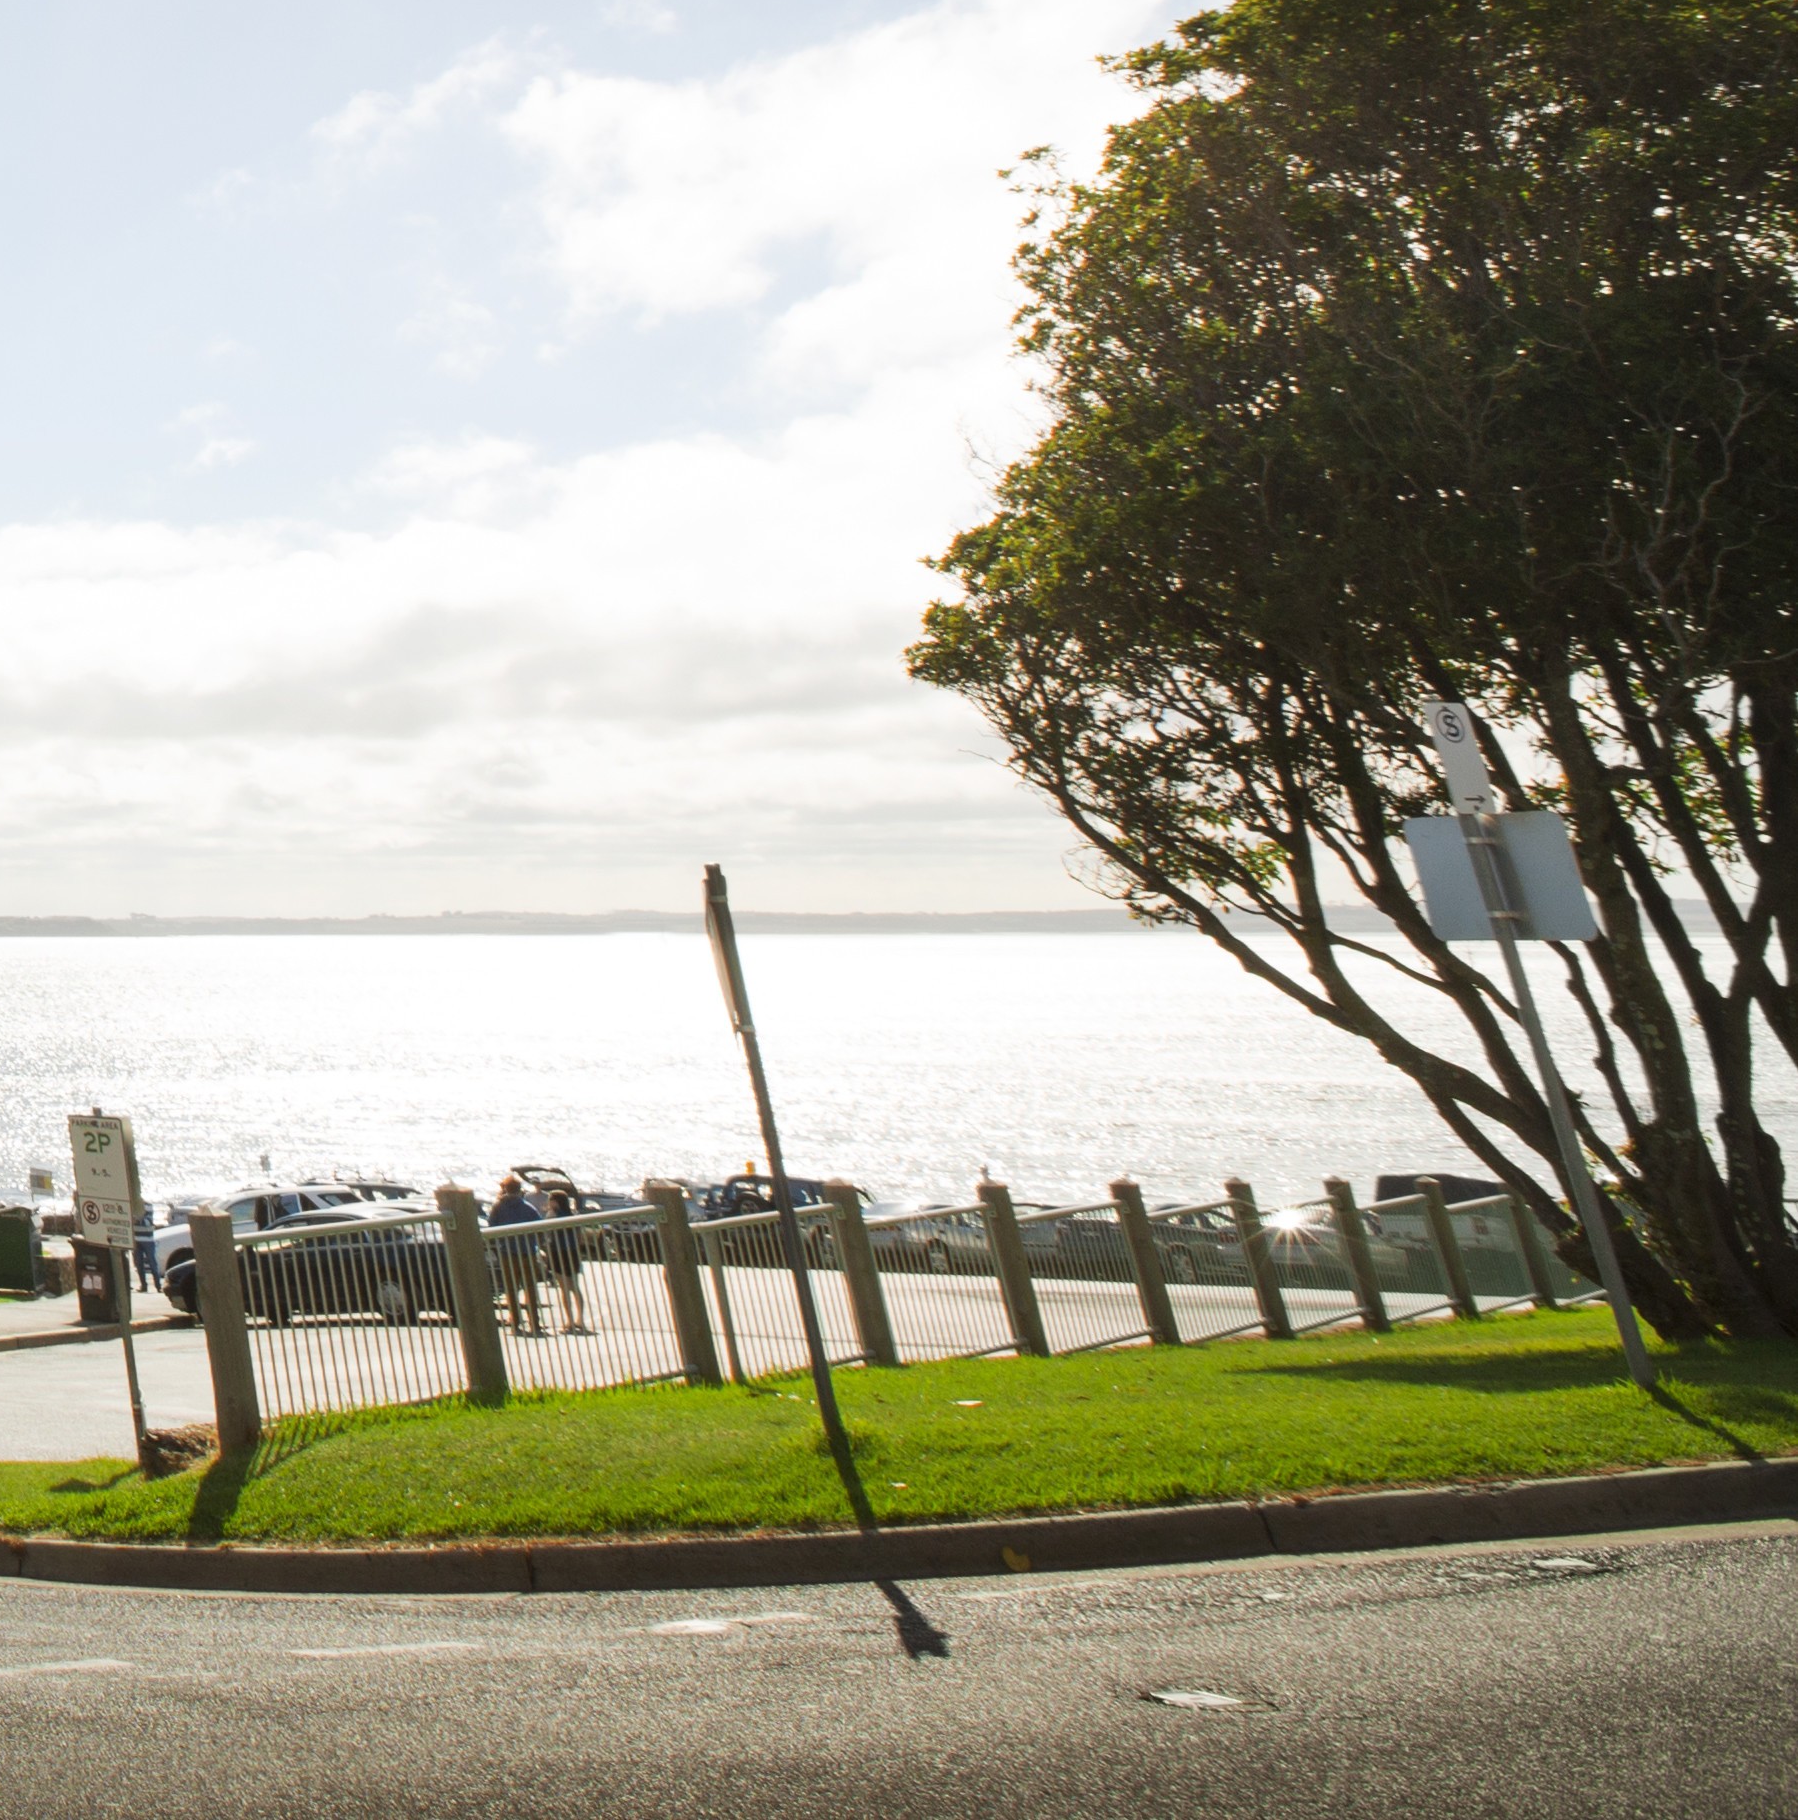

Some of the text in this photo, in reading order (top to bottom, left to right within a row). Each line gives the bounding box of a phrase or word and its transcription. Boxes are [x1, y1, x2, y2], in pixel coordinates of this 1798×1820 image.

[71, 1119, 119, 1130] PARK AREA
[84, 1131, 111, 1153] 2P
